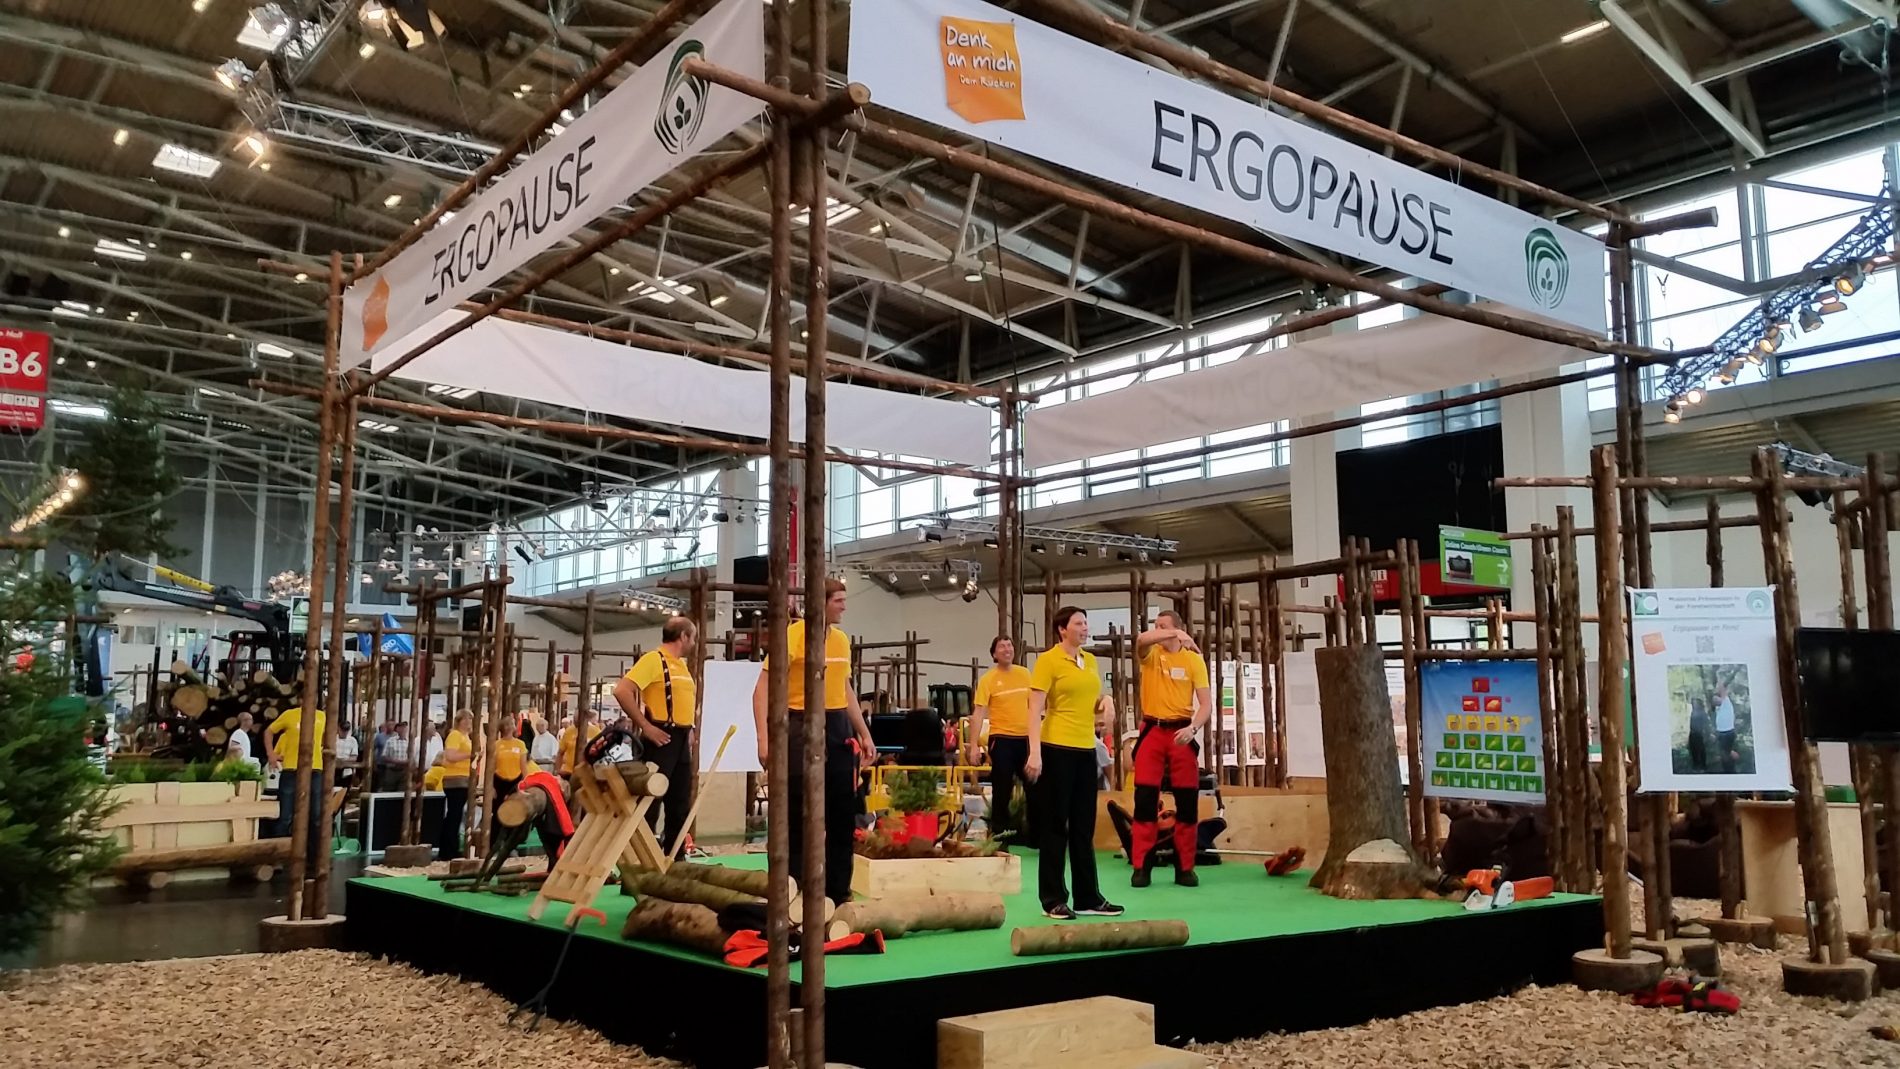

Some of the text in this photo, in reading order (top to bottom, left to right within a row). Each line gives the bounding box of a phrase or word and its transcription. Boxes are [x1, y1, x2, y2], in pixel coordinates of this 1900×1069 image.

[946, 25, 992, 49] Denk
[947, 50, 1016, 72] an mich
[1151, 100, 1453, 265] ERGOPAUSE
[425, 135, 596, 305] ERGOPAUSE
[0, 347, 42, 378] B6
